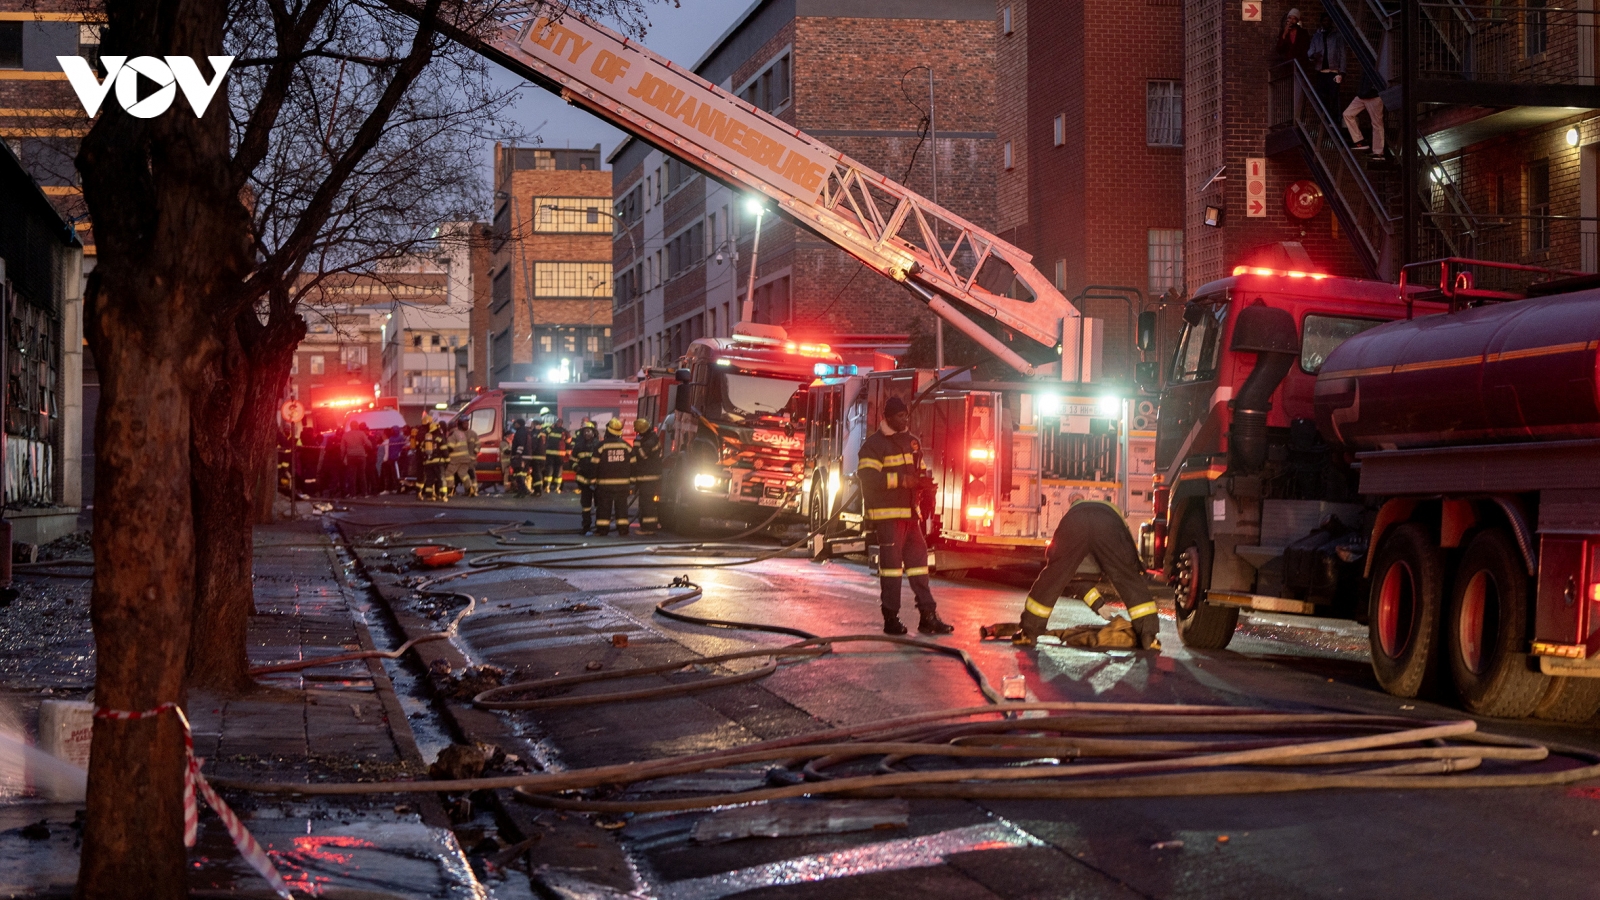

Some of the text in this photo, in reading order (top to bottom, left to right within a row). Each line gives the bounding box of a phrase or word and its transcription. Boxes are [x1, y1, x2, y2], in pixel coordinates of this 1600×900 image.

[530, 16, 827, 194] CITY OF JOHANNESBURG
[752, 431, 801, 448] SCANIA
